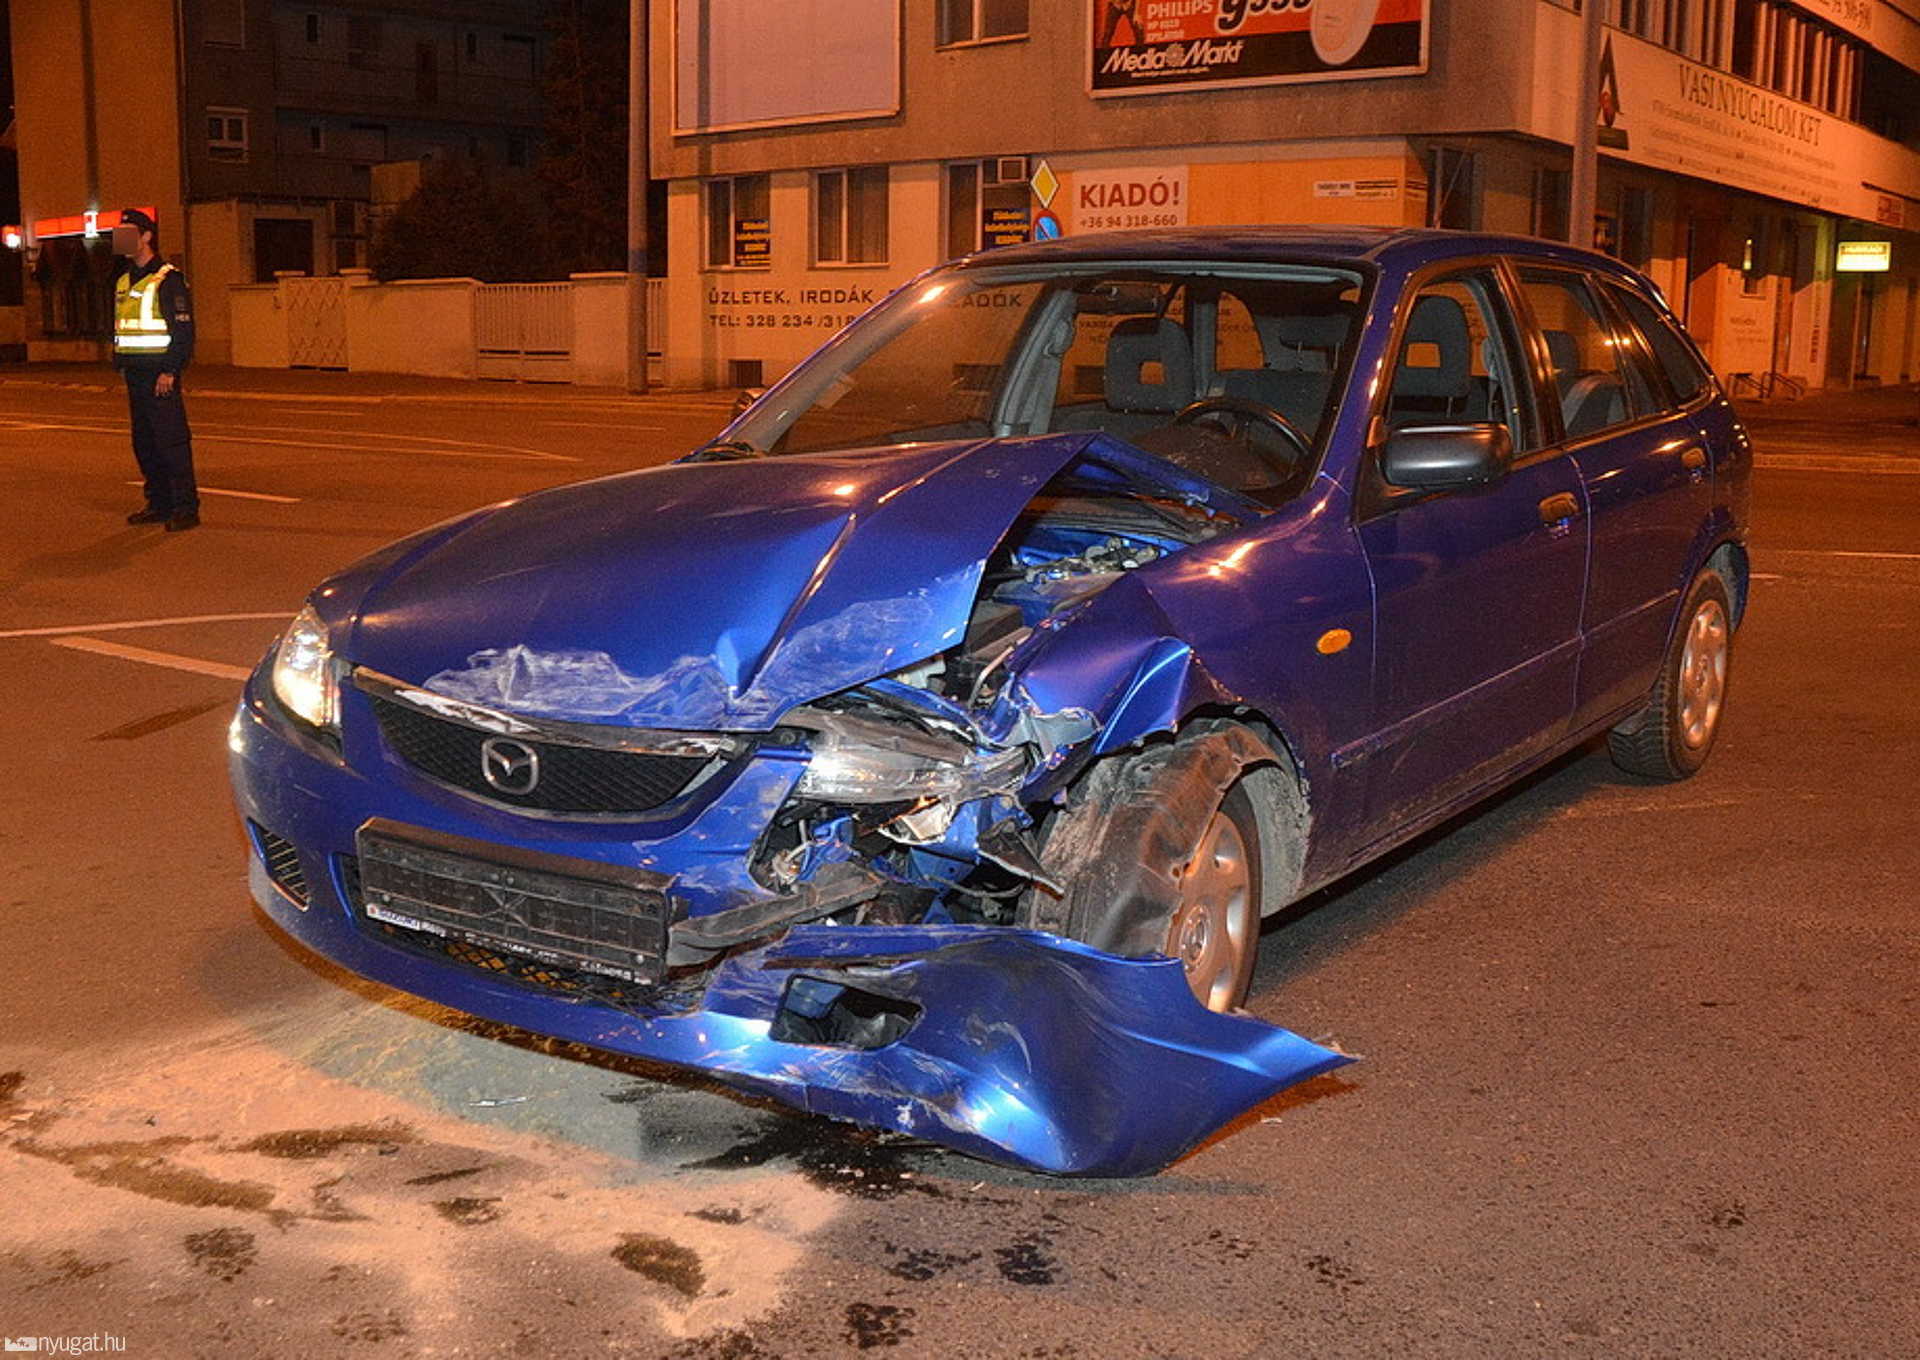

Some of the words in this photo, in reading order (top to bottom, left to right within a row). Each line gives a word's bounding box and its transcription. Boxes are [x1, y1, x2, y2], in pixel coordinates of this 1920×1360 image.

[1147, 1, 1213, 19] PHILIPS
[1100, 47, 1166, 74] Media
[1181, 40, 1244, 67] Markt
[1679, 63, 1714, 108] VASI
[1717, 79, 1796, 139] NYUGALOM
[1080, 175, 1179, 209] KIADÓ!
[1080, 216, 1103, 228] +36
[1107, 215, 1121, 228] 94
[1126, 214, 1178, 228] 318-660
[801, 284, 873, 304] IRODÁK
[709, 314, 740, 327] TEL:
[746, 314, 776, 327] 328
[782, 314, 812, 327] 234
